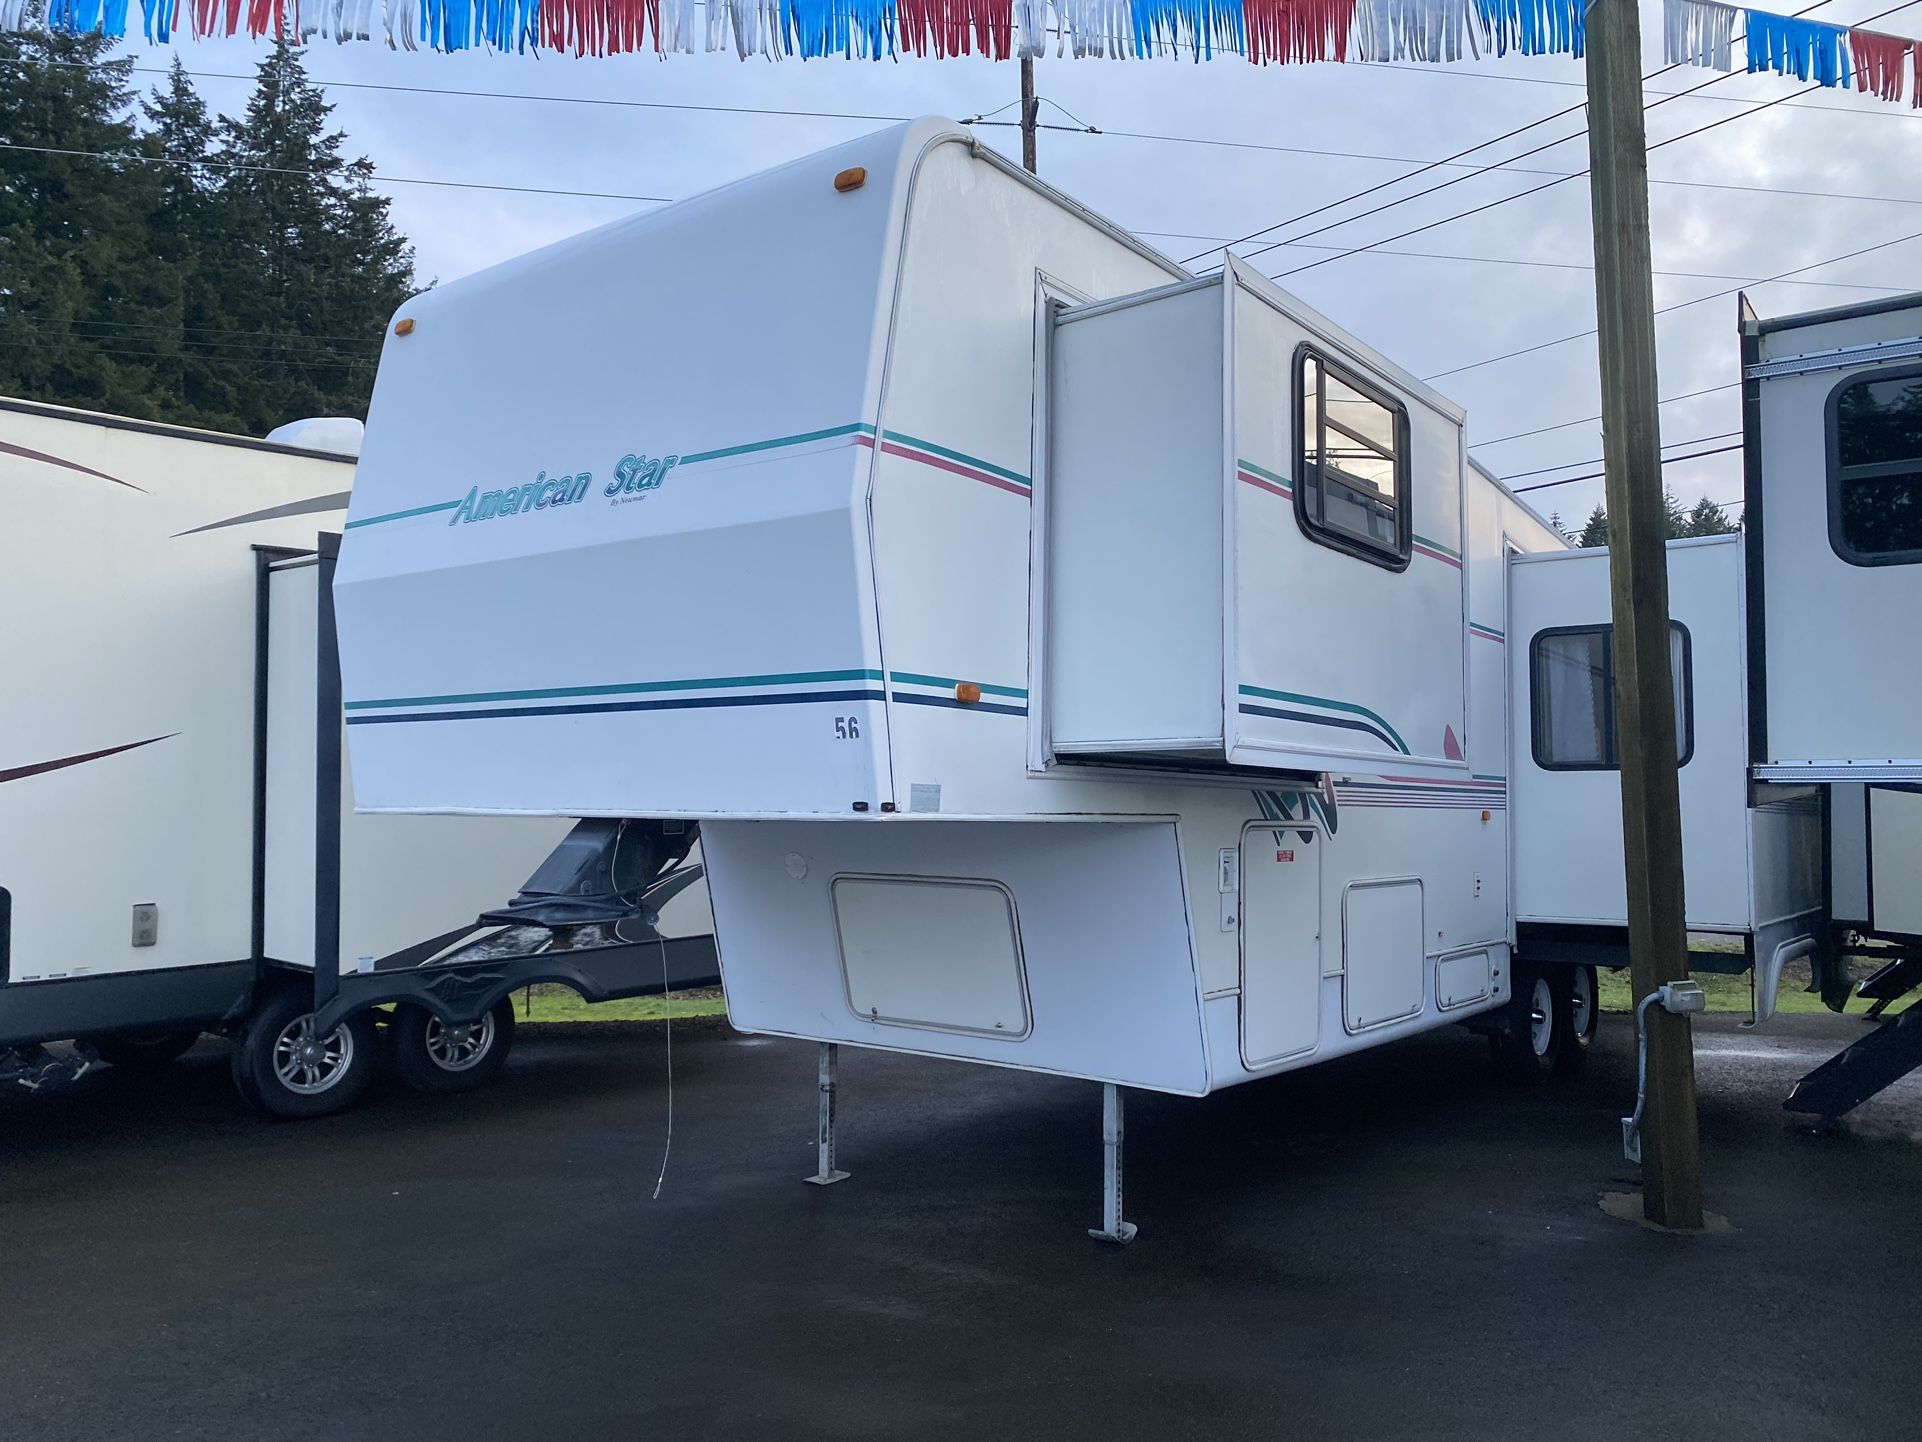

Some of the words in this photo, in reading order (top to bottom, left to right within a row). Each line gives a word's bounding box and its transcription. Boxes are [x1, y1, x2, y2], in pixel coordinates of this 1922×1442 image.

[449, 471, 592, 526] American
[604, 454, 678, 497] Star
[835, 717, 859, 739] 56
